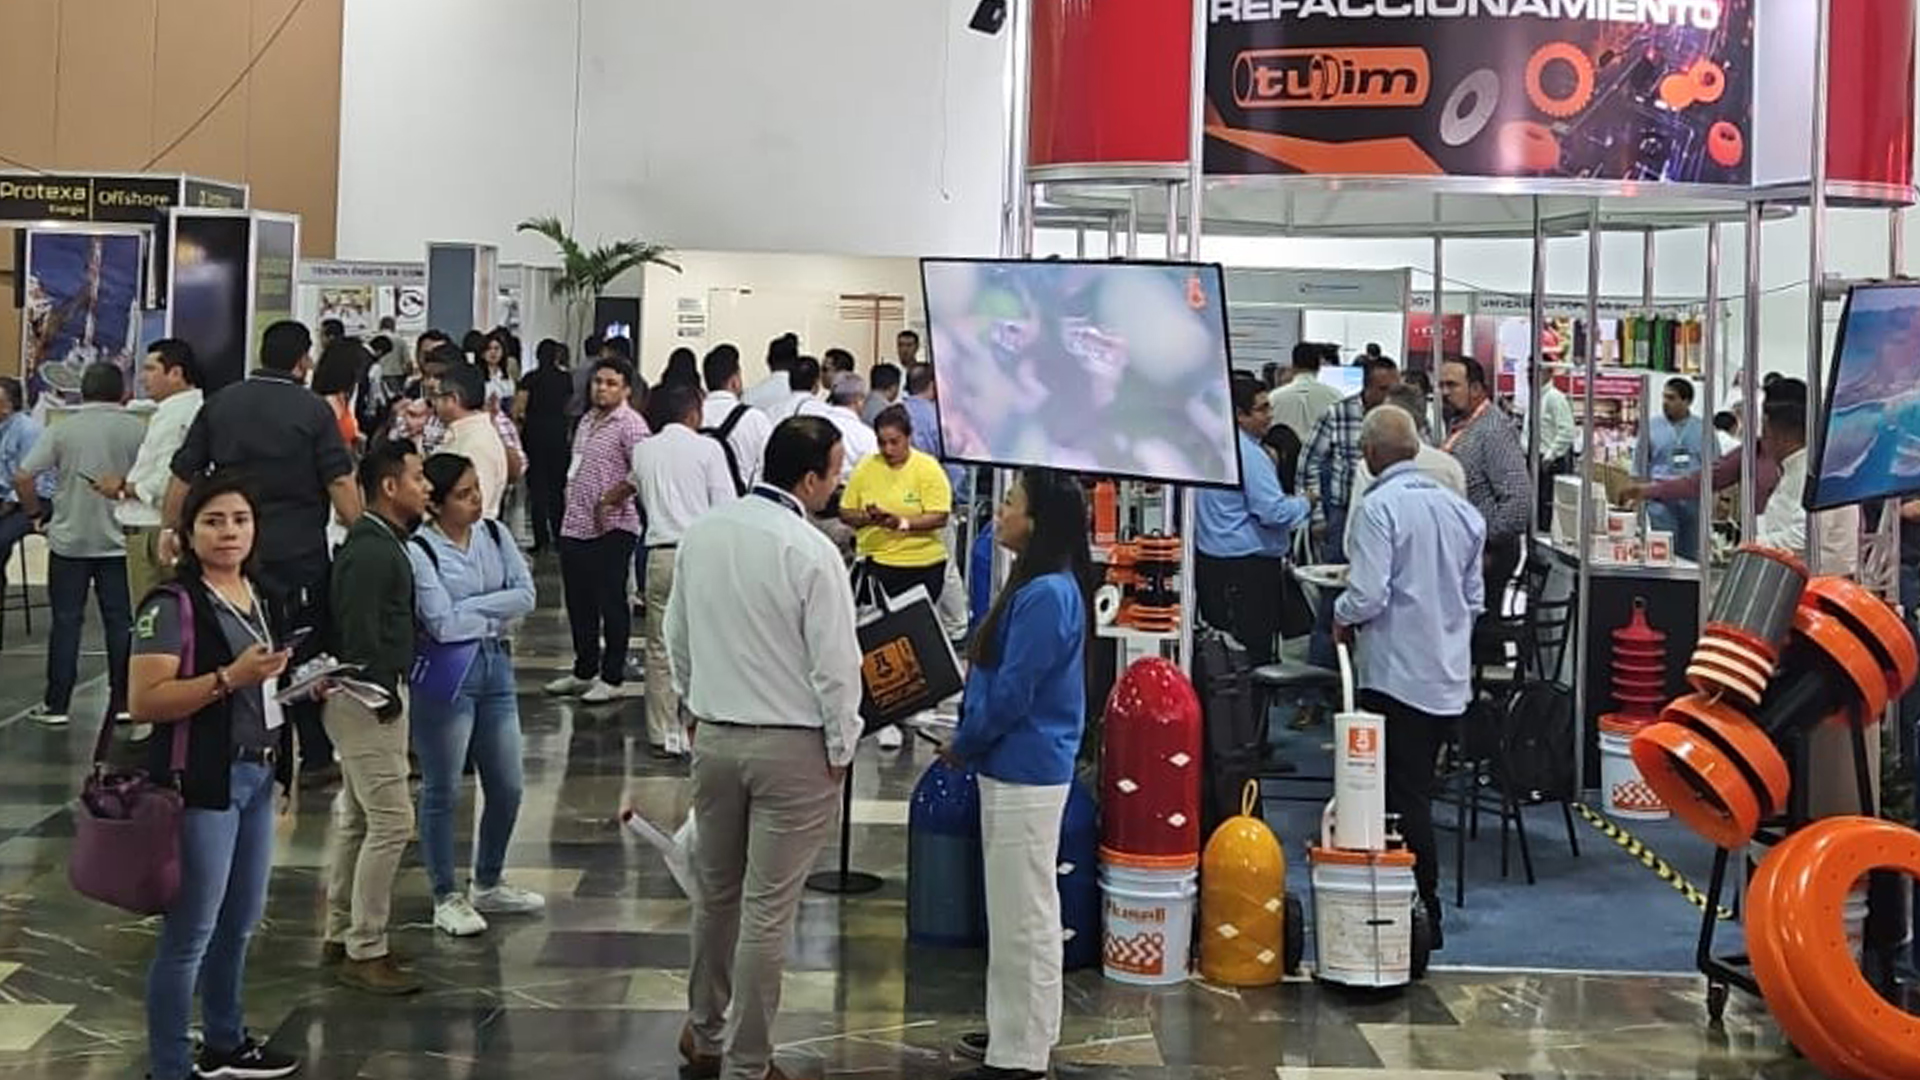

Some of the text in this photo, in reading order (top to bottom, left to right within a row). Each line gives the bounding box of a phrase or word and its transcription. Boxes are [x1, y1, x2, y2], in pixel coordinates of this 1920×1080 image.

[1209, 0, 1721, 29] REFACCIONAMIENTO
[0, 180, 87, 201] Protexa
[97, 189, 170, 207] Offshore
